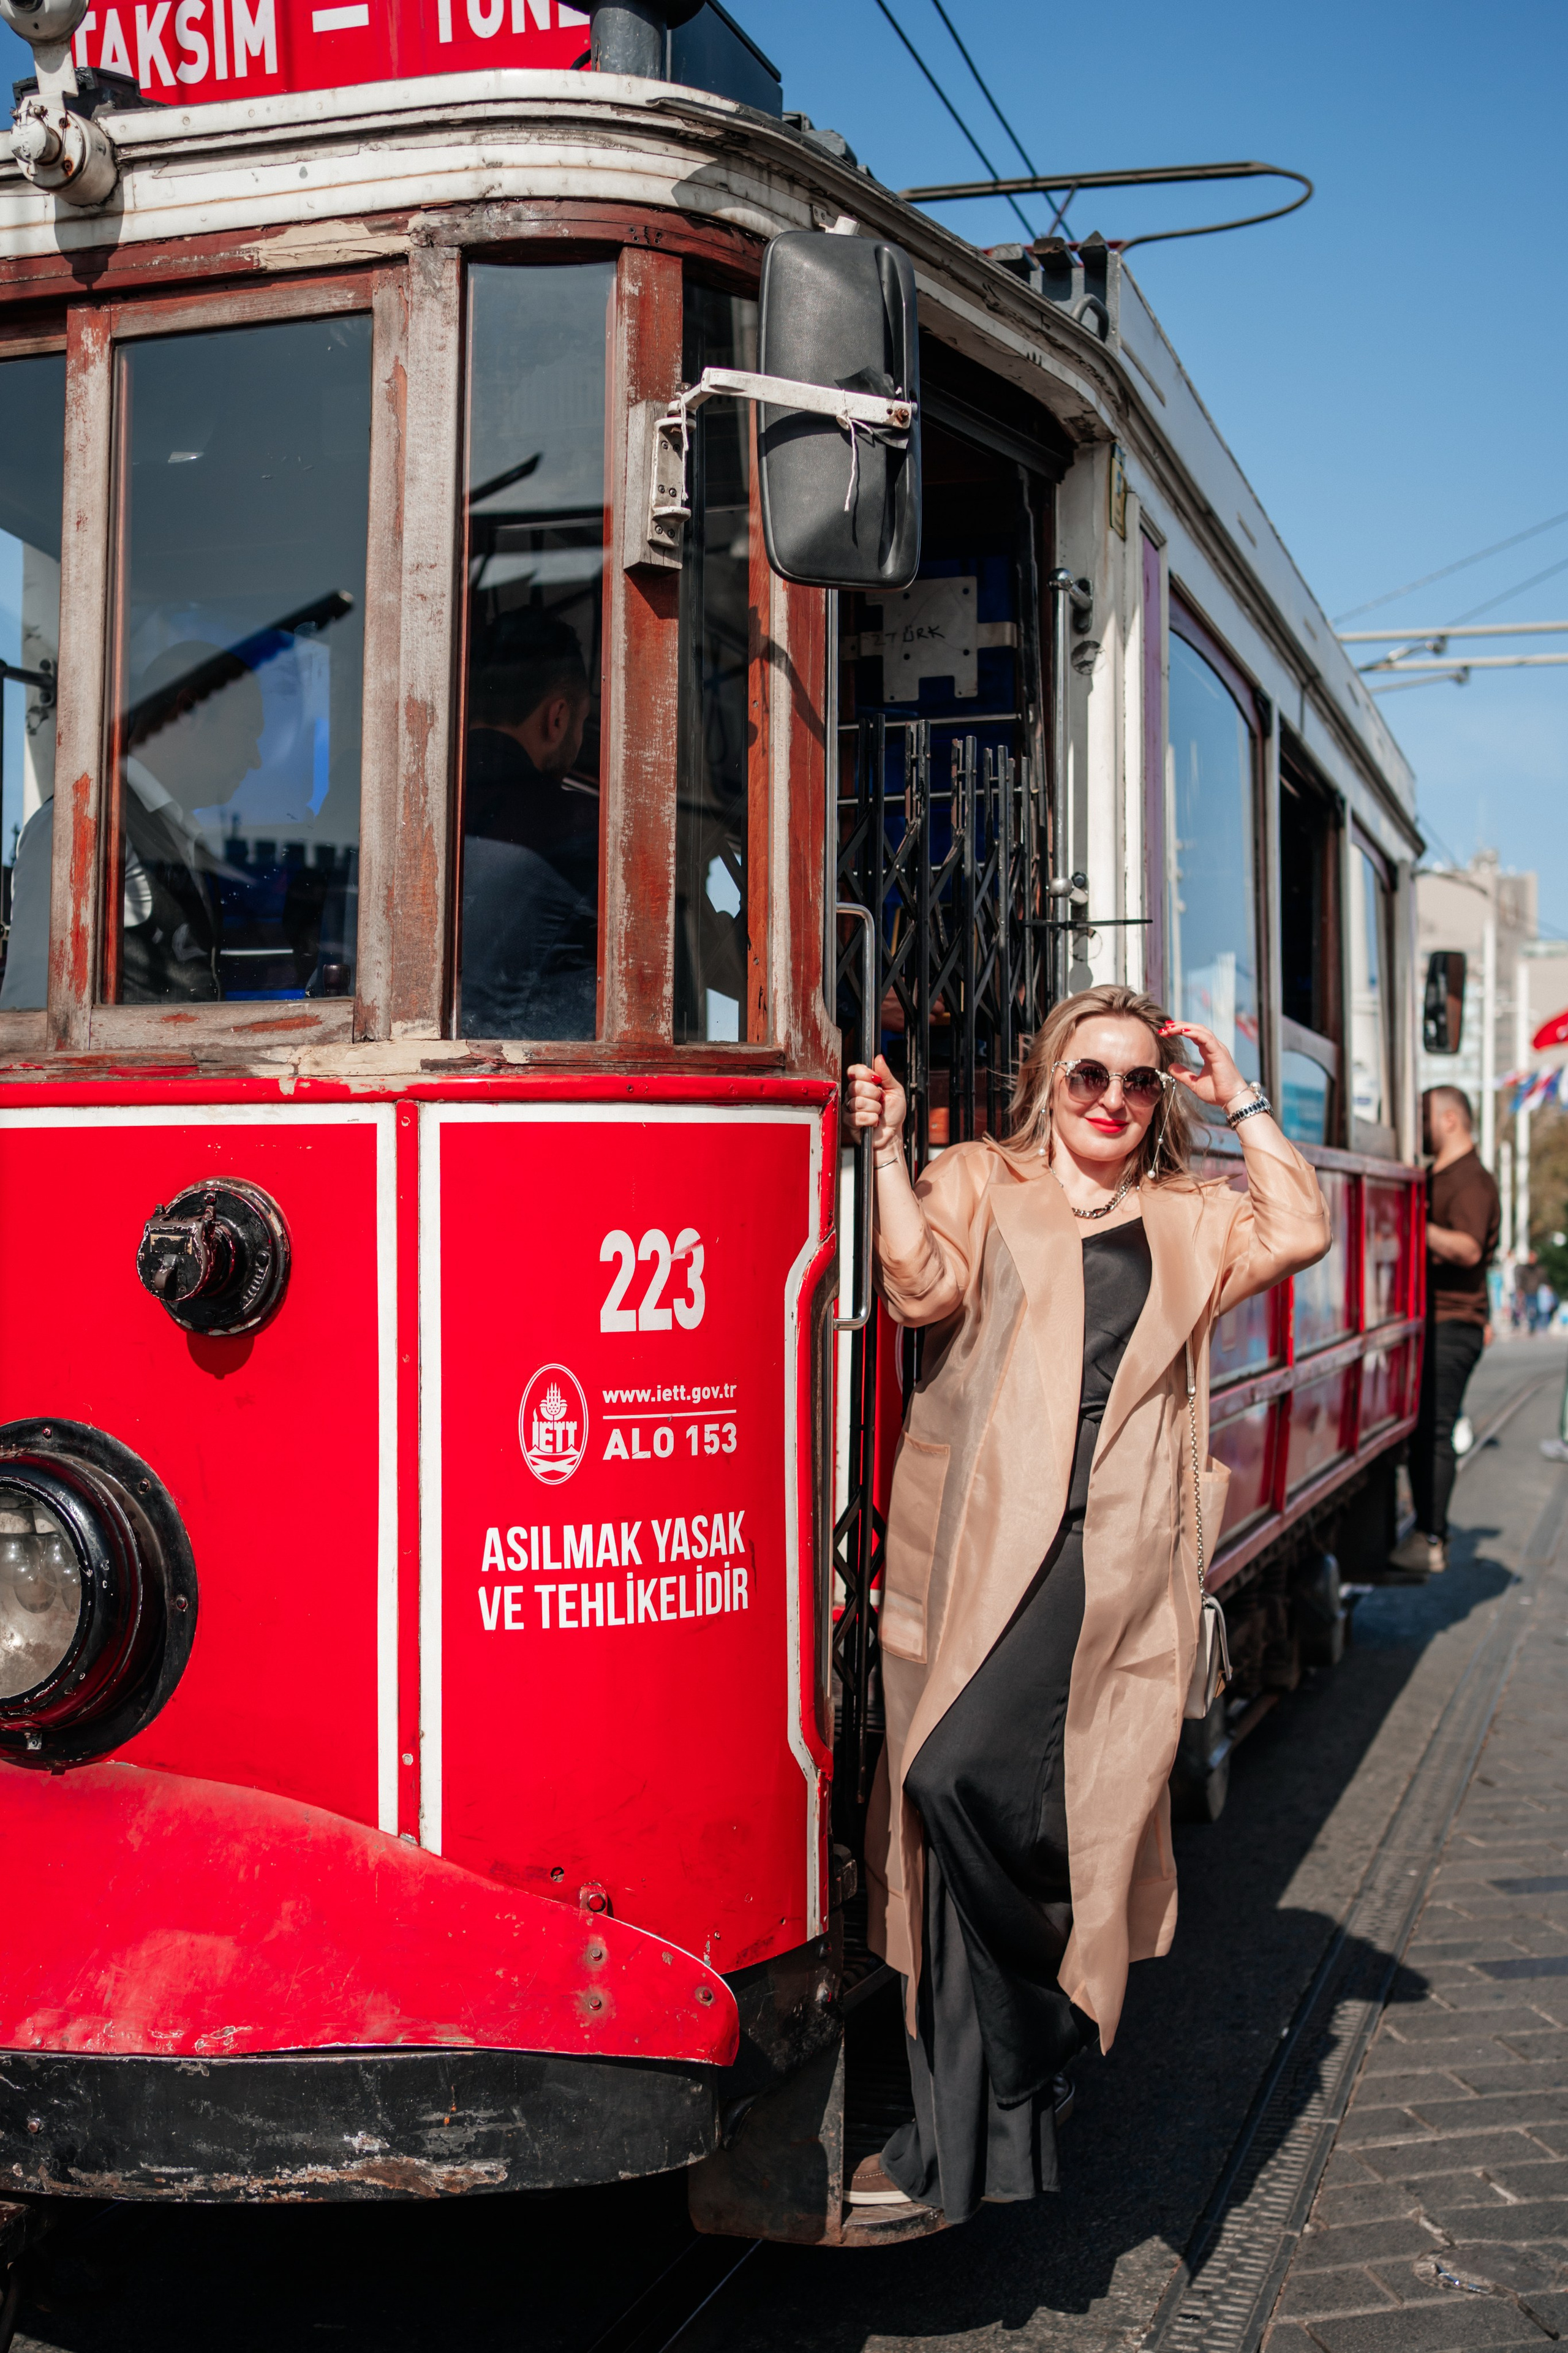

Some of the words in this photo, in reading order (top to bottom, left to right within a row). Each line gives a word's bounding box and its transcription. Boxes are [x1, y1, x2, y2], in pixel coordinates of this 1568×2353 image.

[74, 0, 278, 89] TAKSIM
[600, 1228, 706, 1332] 223
[603, 1384, 737, 1403] www.iett.gov.tr
[603, 1426, 674, 1460] ALO
[686, 1422, 737, 1456] 153
[481, 1521, 643, 1572] ASILMAK
[651, 1511, 745, 1563] YASAK
[478, 1585, 524, 1631] VE
[535, 1562, 748, 1629] TEHLİKELİDİR
